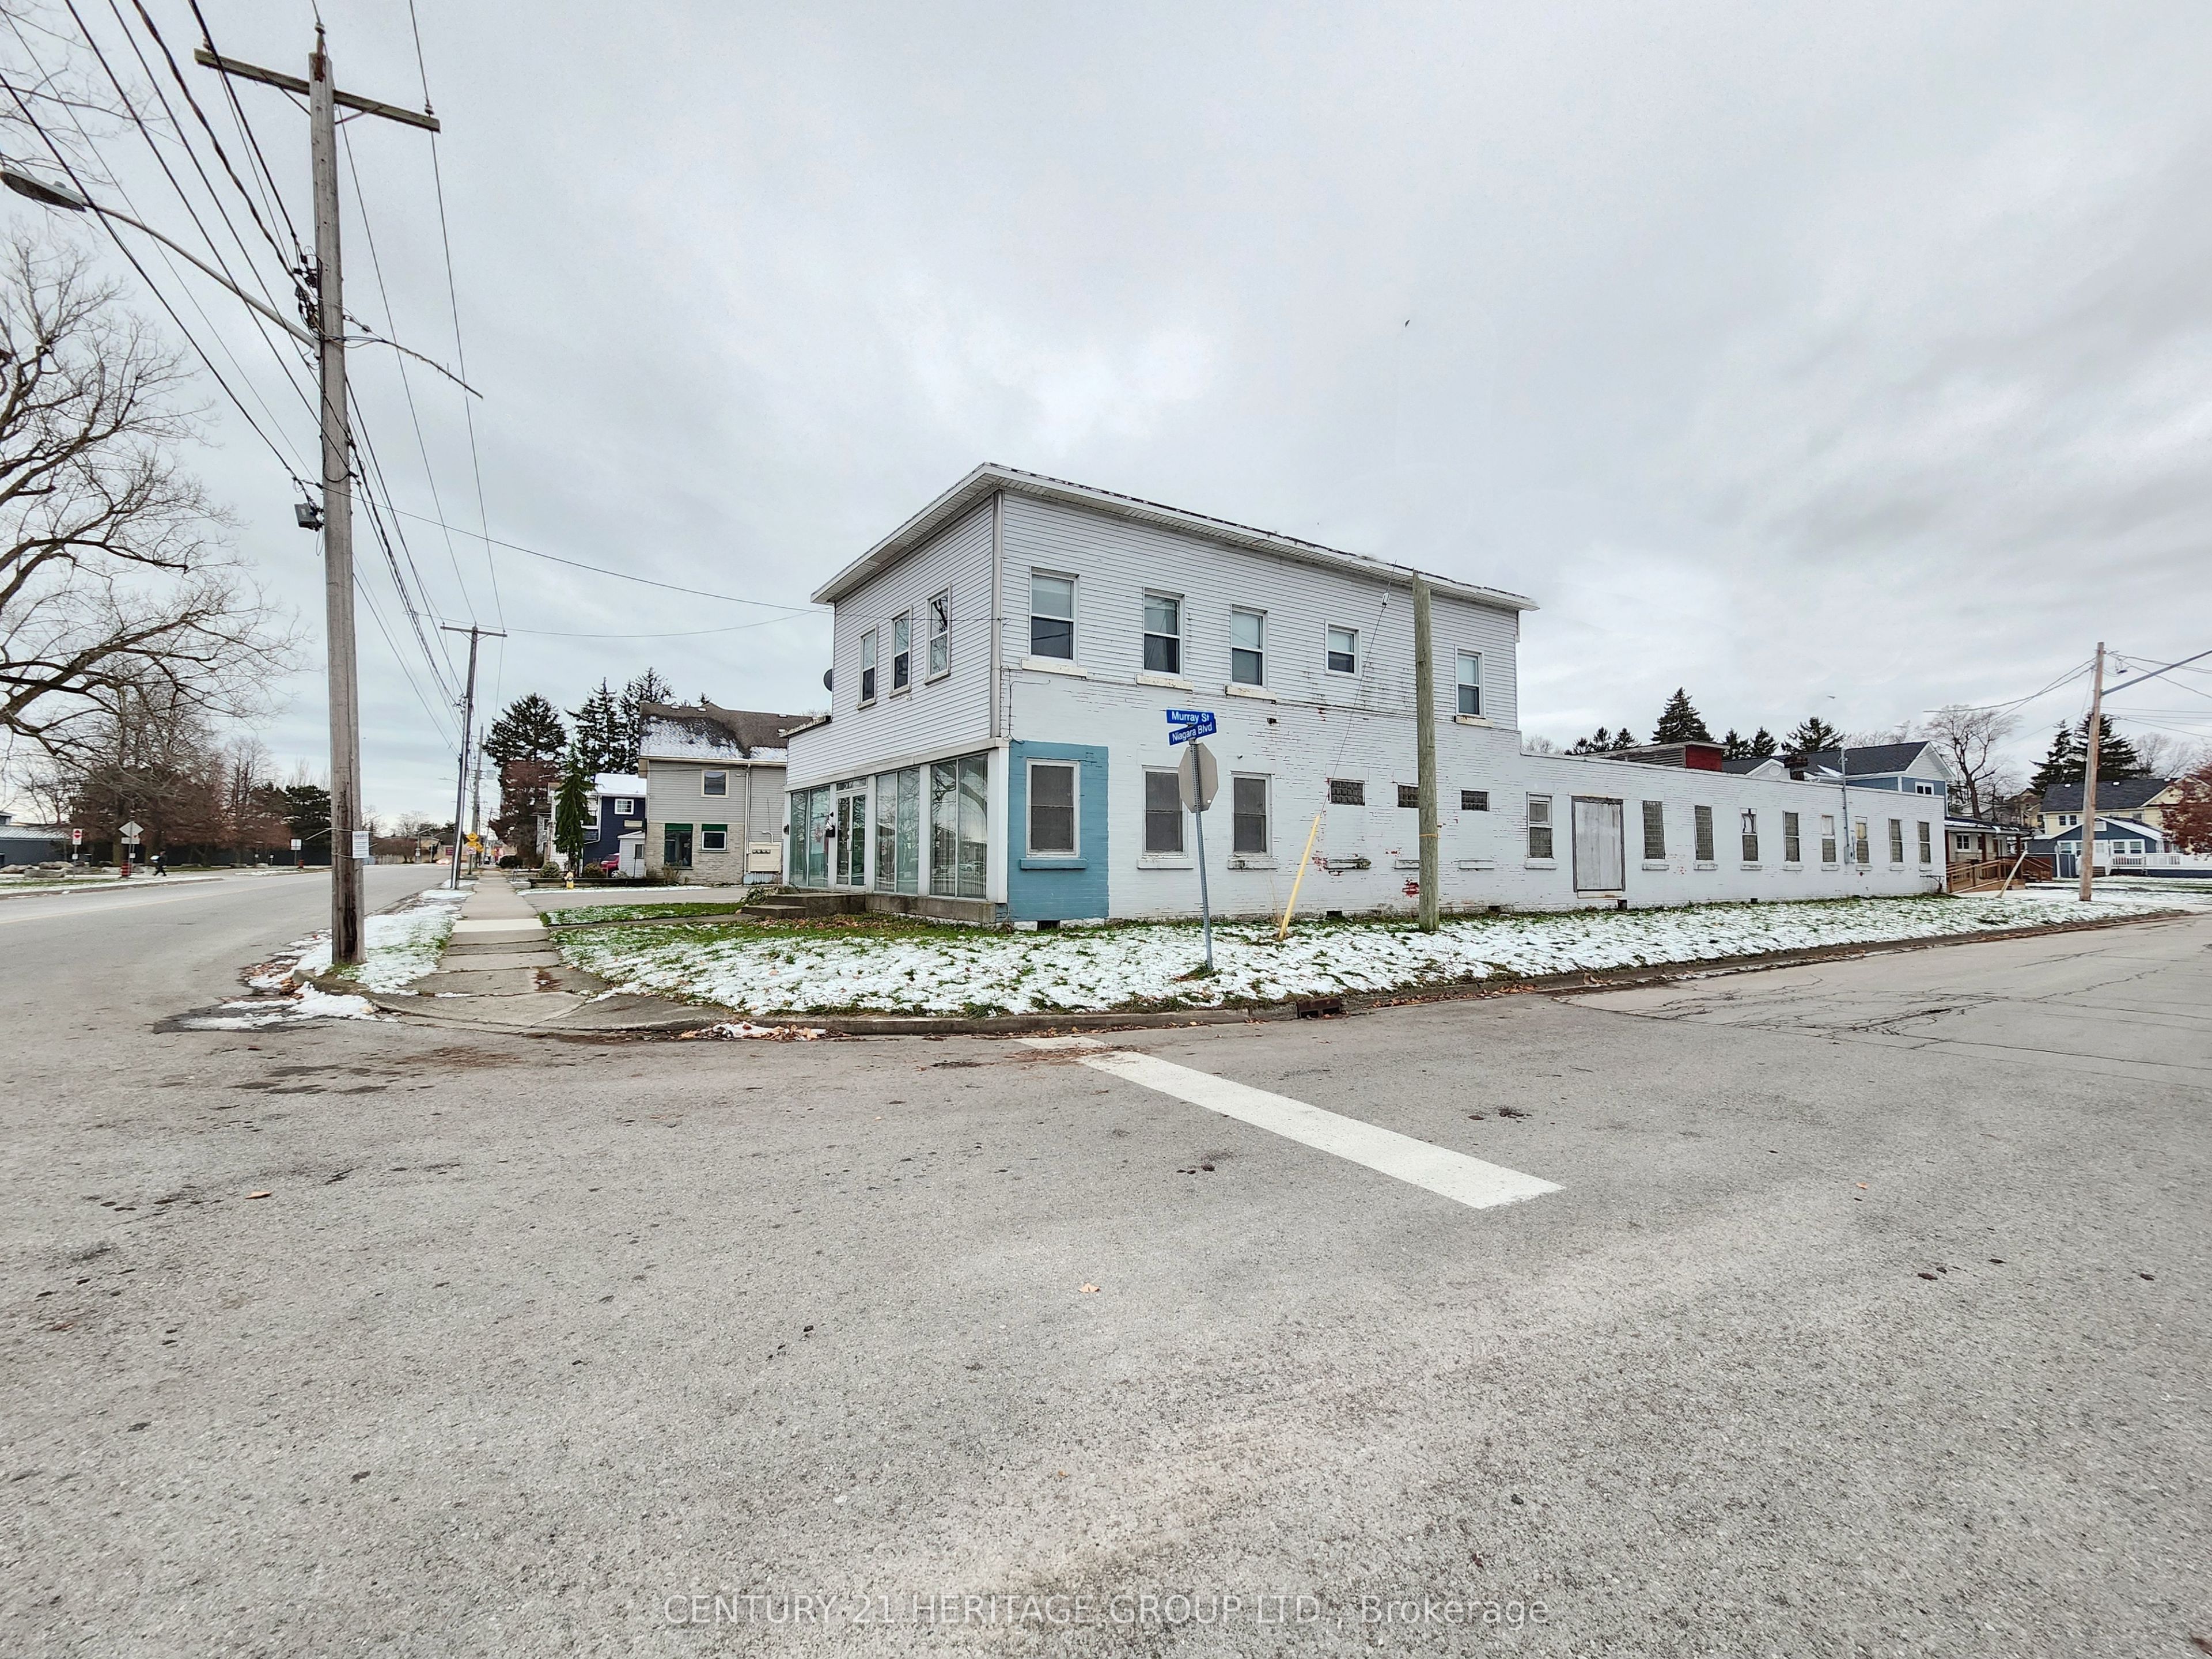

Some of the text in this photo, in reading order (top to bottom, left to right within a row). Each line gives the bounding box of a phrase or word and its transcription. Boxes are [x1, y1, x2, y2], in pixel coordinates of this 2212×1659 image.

[1171, 711, 1210, 724] Murray St
[1172, 722, 1213, 742] Niagara Blvd
